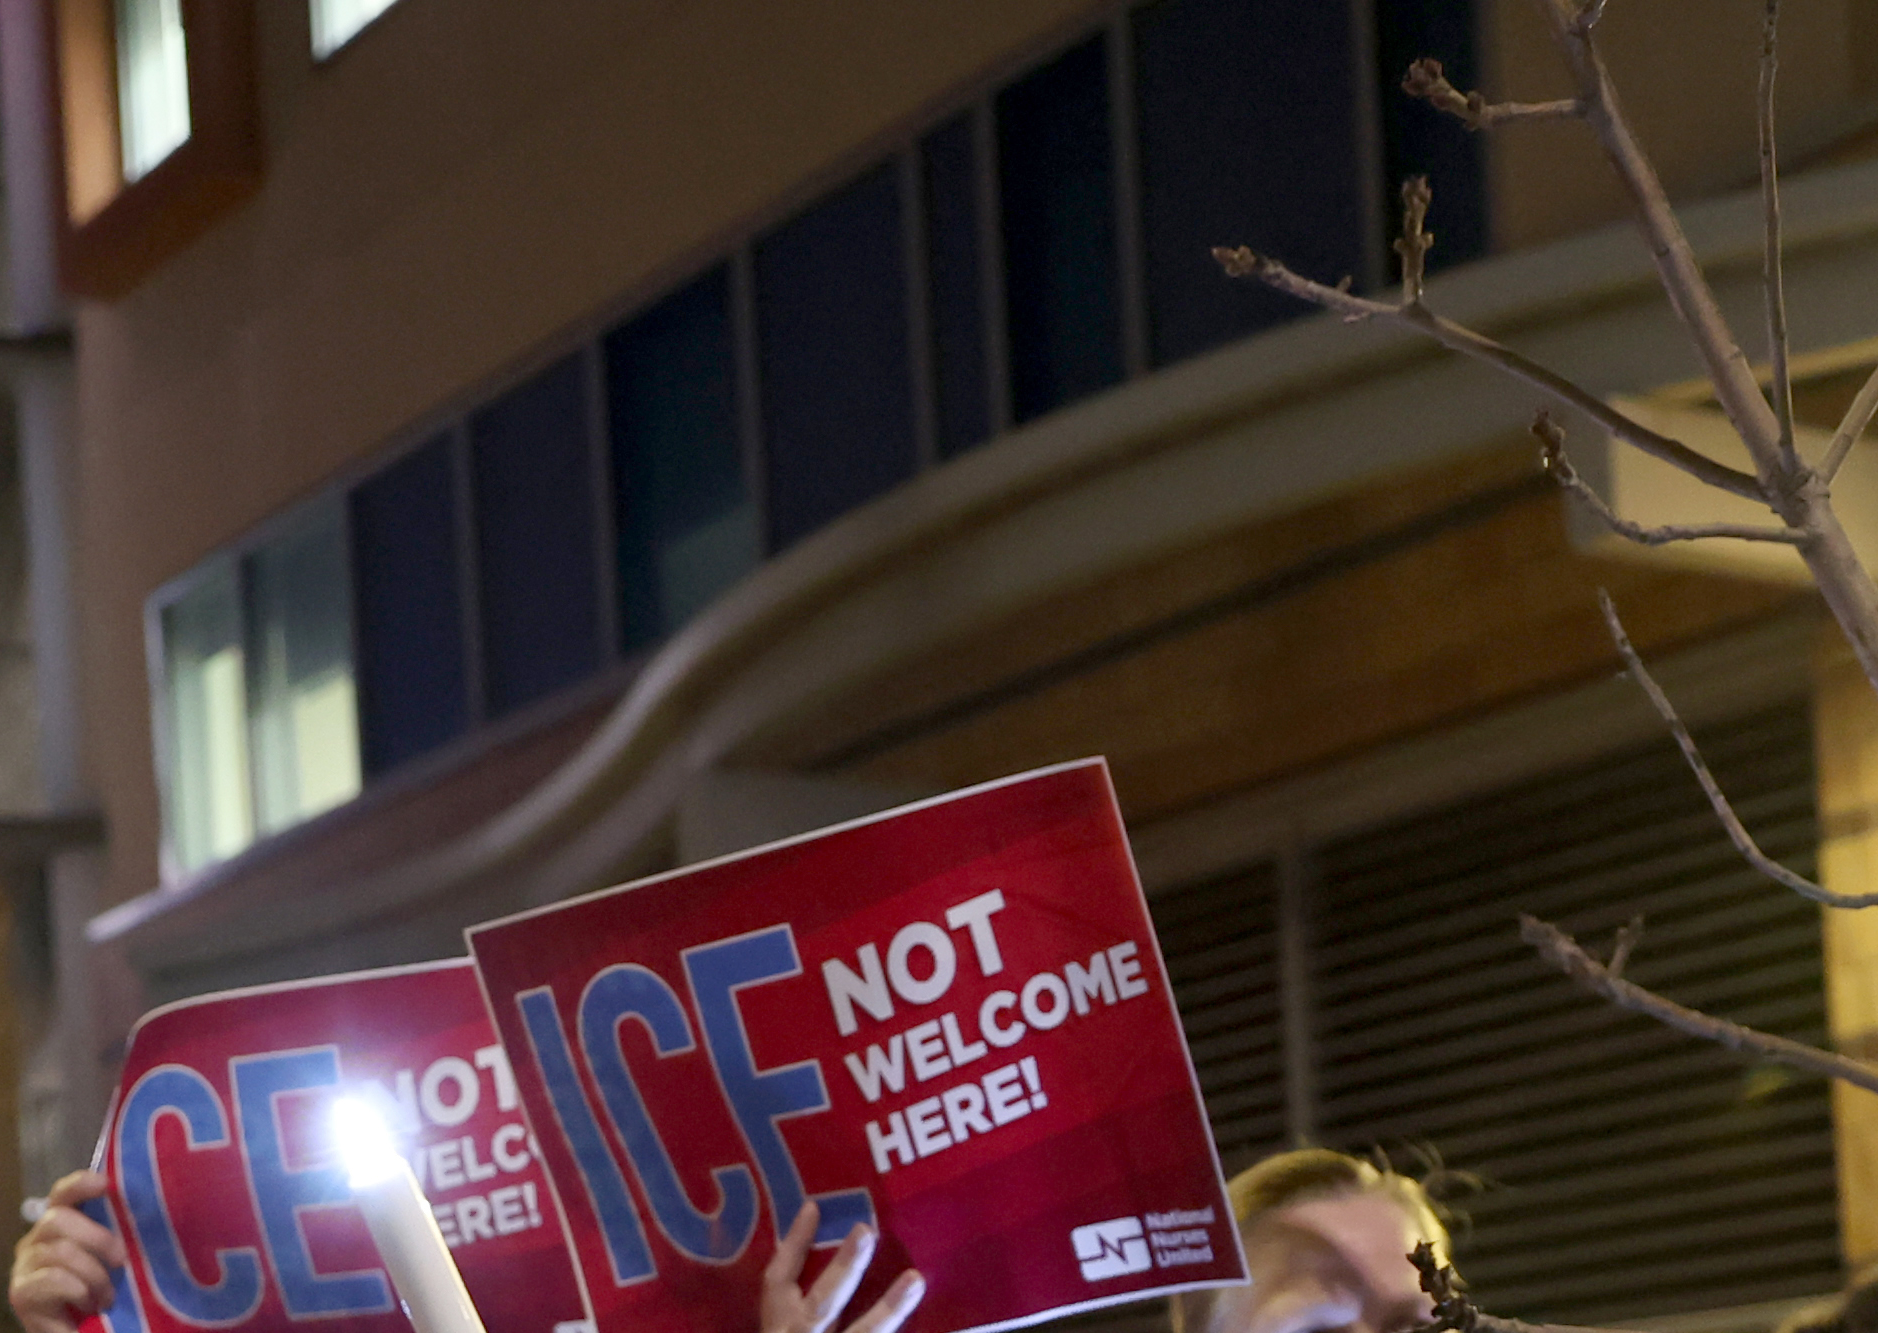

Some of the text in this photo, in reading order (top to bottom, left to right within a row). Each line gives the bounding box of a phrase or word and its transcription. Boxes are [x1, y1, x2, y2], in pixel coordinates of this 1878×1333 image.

[821, 888, 1006, 1037] NOT
[844, 940, 1149, 1103] WELCOME
[516, 923, 879, 1288] ICE
[865, 1055, 1049, 1175] HERE!
[430, 1181, 543, 1248] ERE!
